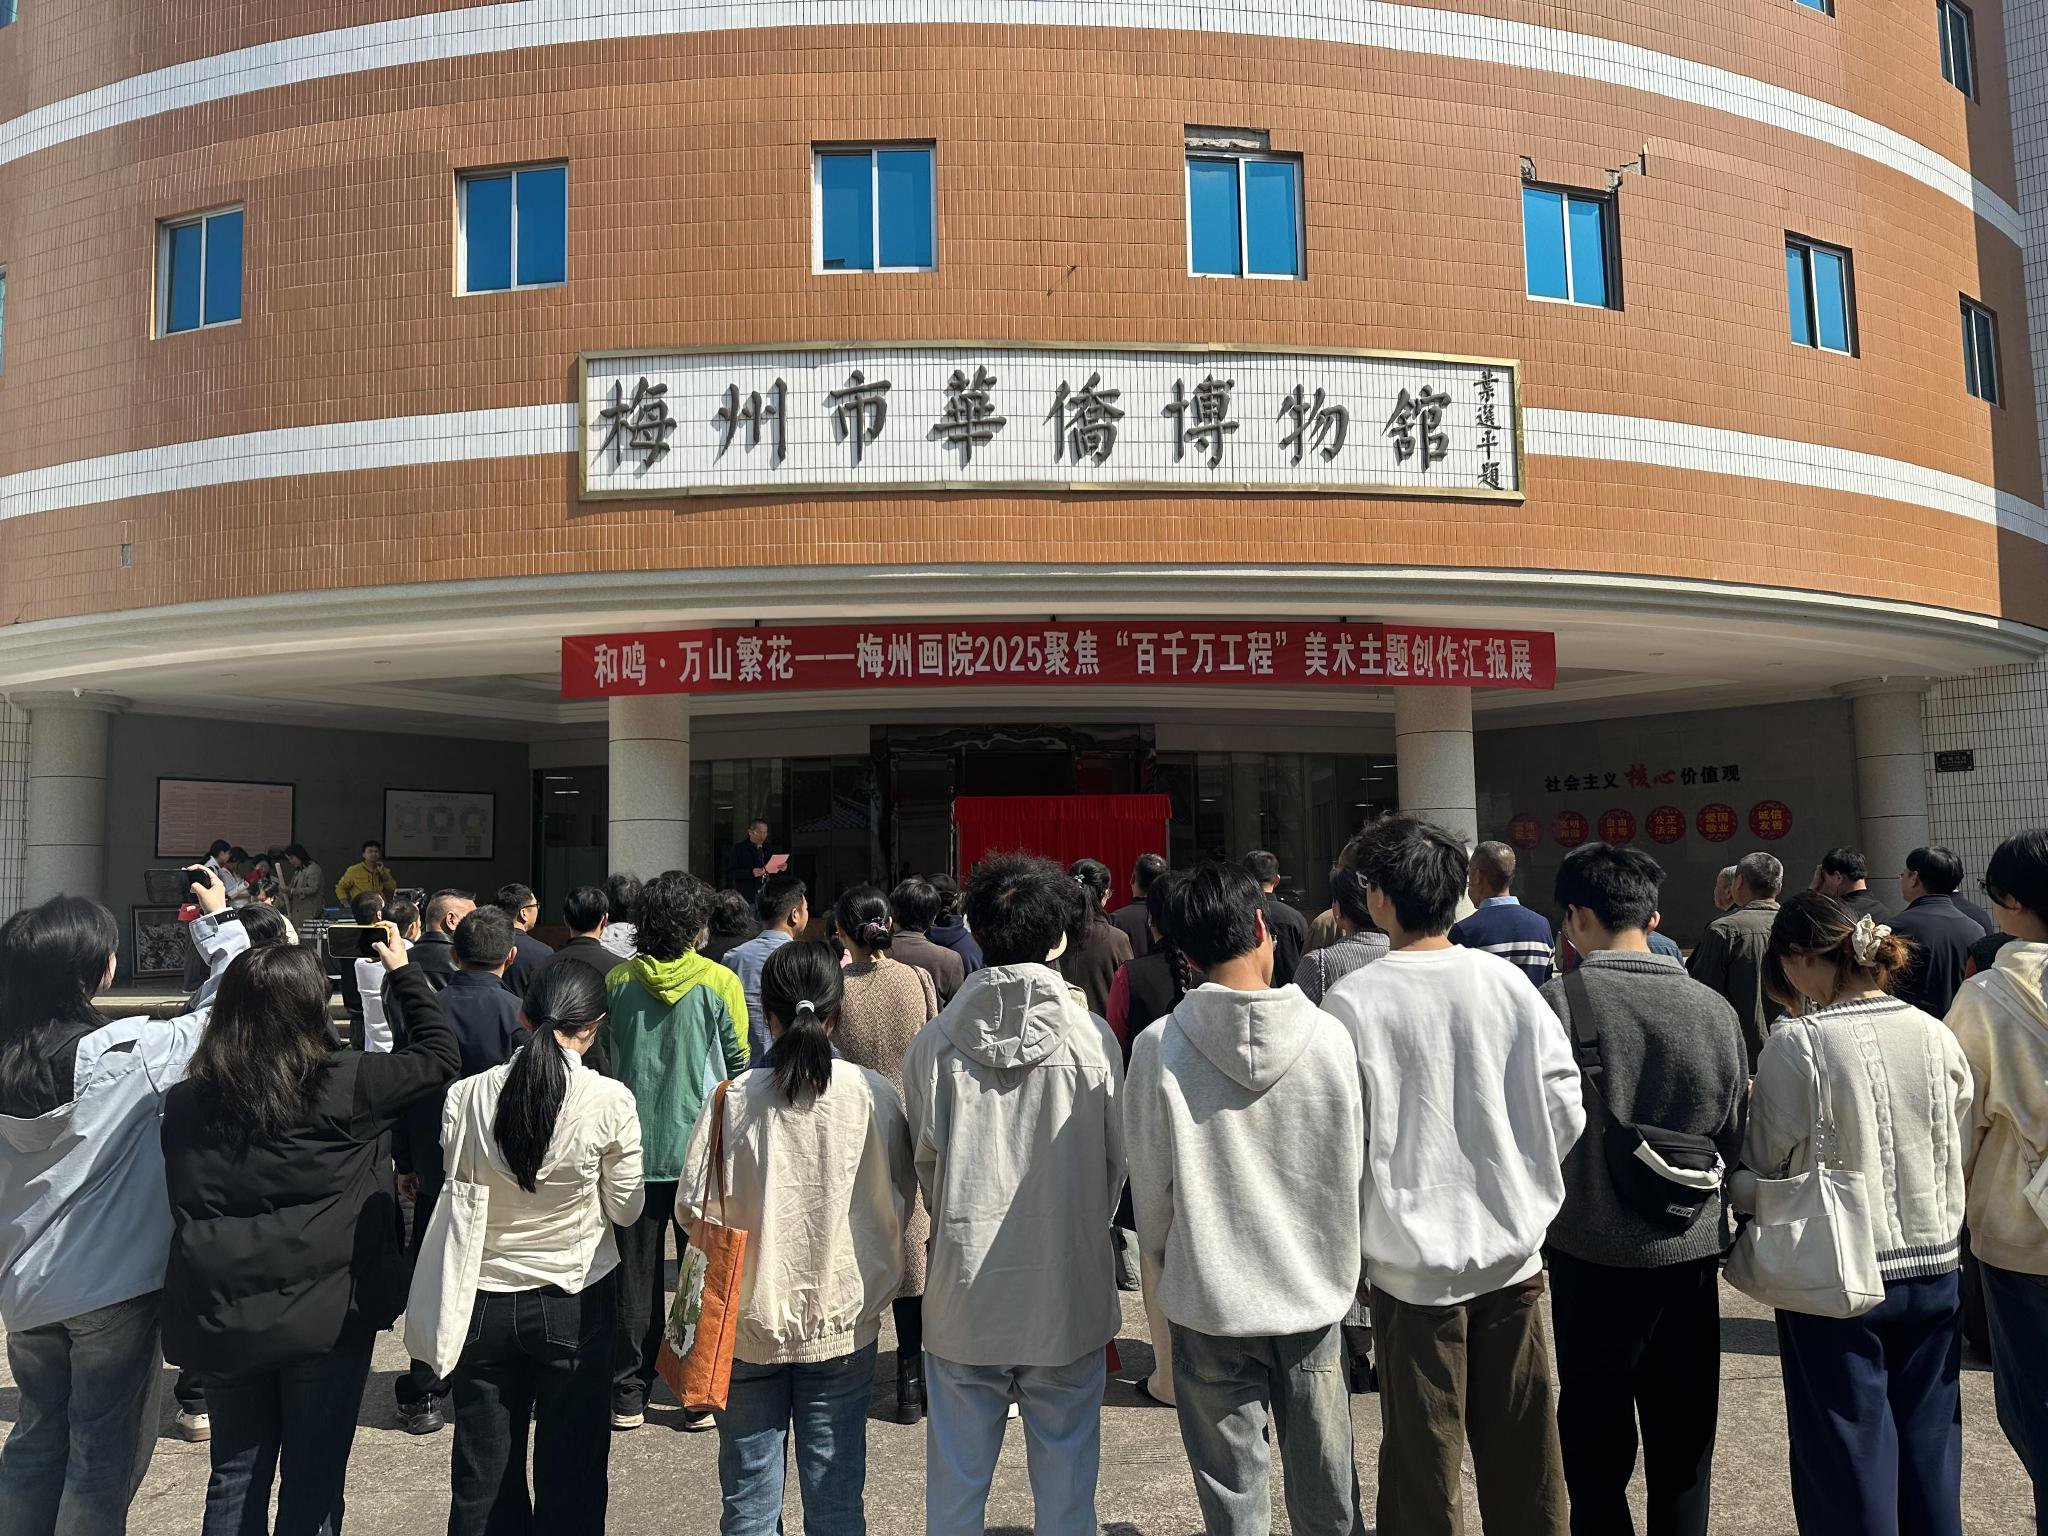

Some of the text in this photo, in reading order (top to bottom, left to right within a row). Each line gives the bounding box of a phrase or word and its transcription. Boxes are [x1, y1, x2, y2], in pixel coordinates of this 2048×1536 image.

[1473, 368, 1505, 491] 葉選平題
[1544, 763, 1741, 792] 社会主义核心价值观
[1655, 815, 1677, 825] 公正
[1655, 825, 1677, 834] 法治
